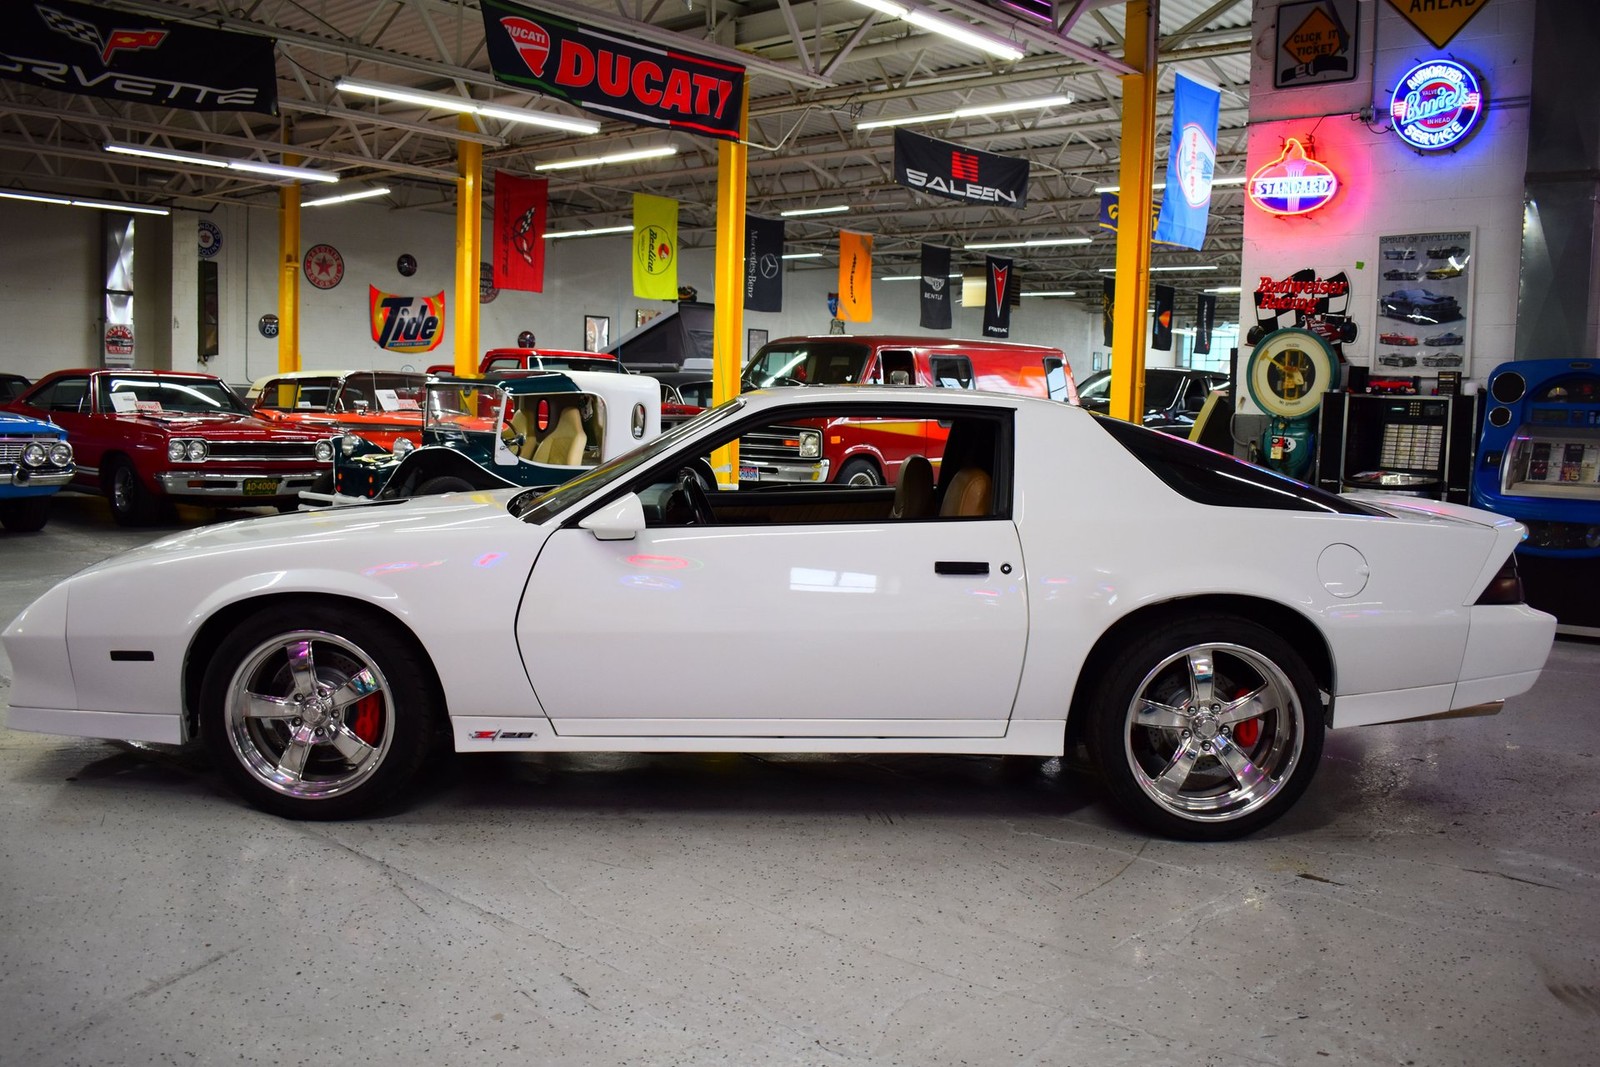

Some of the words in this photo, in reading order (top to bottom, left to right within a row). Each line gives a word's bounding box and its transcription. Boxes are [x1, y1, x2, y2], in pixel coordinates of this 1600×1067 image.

[504, 23, 546, 44] DUCATI
[1294, 31, 1322, 43] CLICK
[1328, 30, 1338, 39] IT
[1297, 43, 1333, 56] TICKET
[0, 51, 259, 105] ORVETTE
[1406, 65, 1463, 90] AUTHORIZED
[1404, 120, 1463, 145] SERVICE
[906, 168, 1017, 202] SALEEN
[1254, 180, 1333, 195] STANDARD
[648, 228, 657, 272] Beeline
[748, 229, 758, 298] Mercedes-Benz
[924, 292, 943, 301] BENTLE
[1257, 276, 1348, 295] Budweiser
[1259, 291, 1320, 315] Racing
[264, 324, 277, 335] 66
[379, 297, 439, 349] Tide
[988, 325, 1008, 333] PNTIAC
